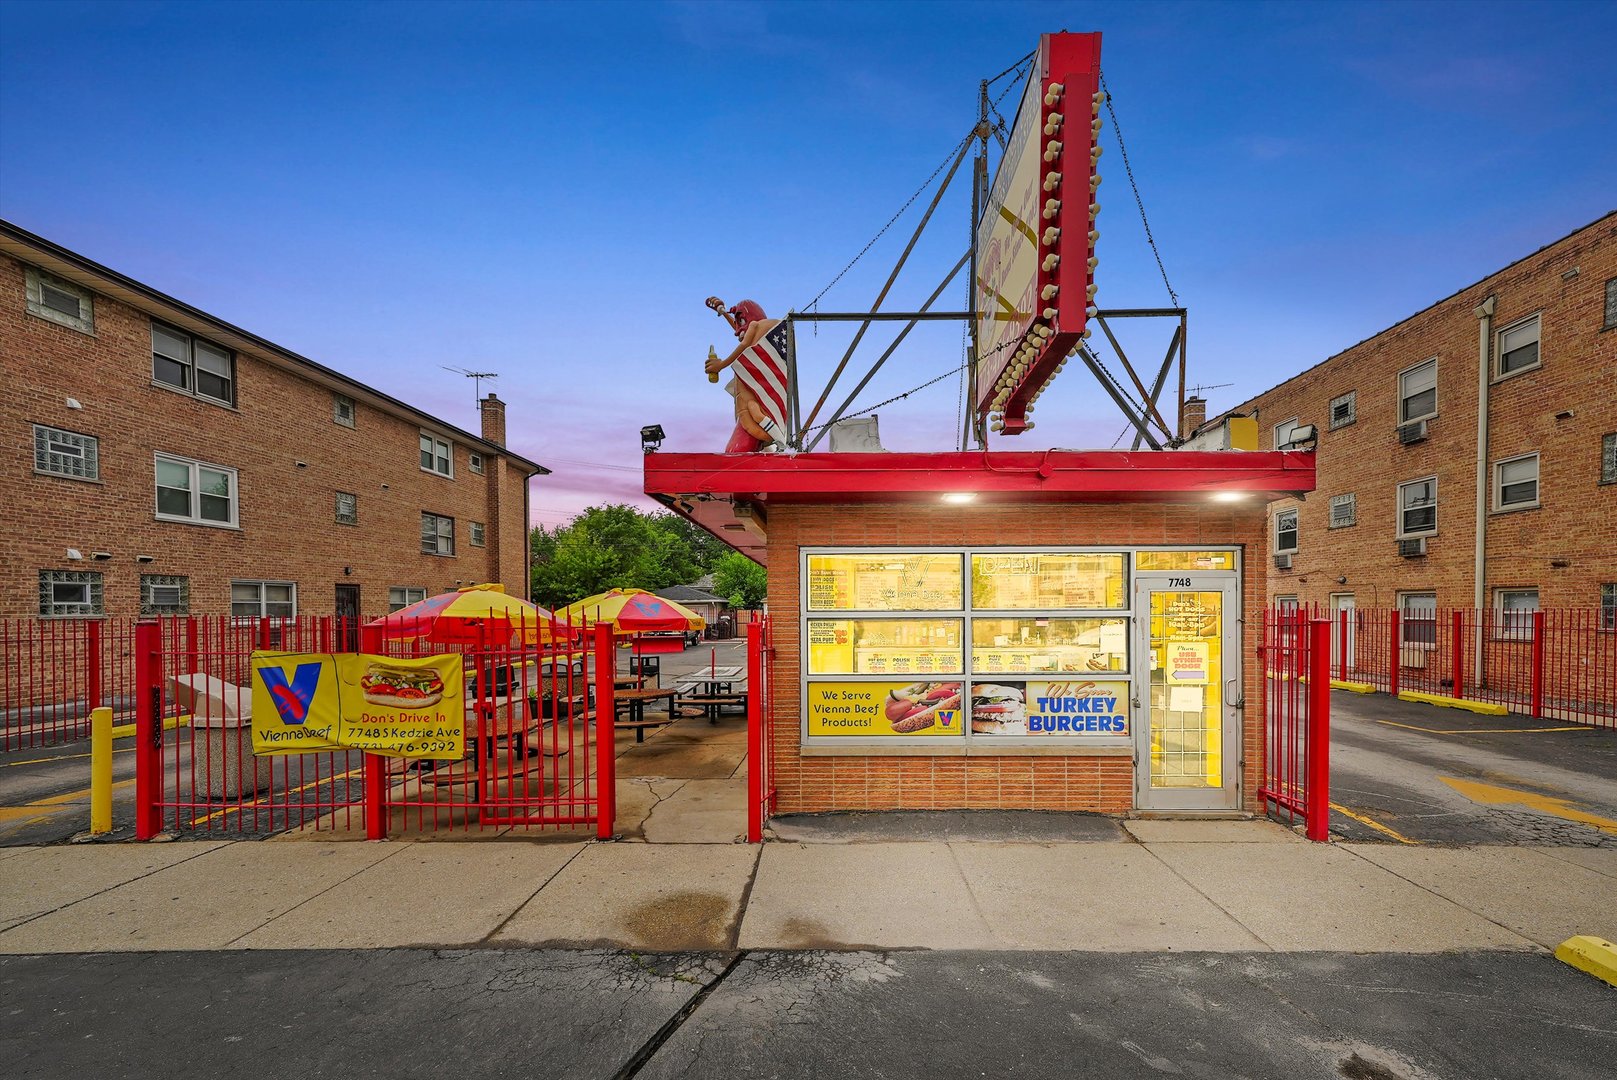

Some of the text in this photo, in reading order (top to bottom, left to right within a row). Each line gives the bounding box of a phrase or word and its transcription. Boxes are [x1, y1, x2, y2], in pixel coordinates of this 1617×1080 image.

[1168, 578, 1191, 587] 7748
[821, 690, 871, 700] We Serve
[1045, 681, 1113, 699] We Serve
[814, 703, 880, 715] Vienna Beef
[1036, 697, 1117, 713] TURKEY
[362, 712, 446, 723] Don's Drive In
[822, 717, 872, 727] Products!
[1028, 715, 1125, 732] BURGERS
[348, 727, 460, 738] 7748 S Kedzie Ave
